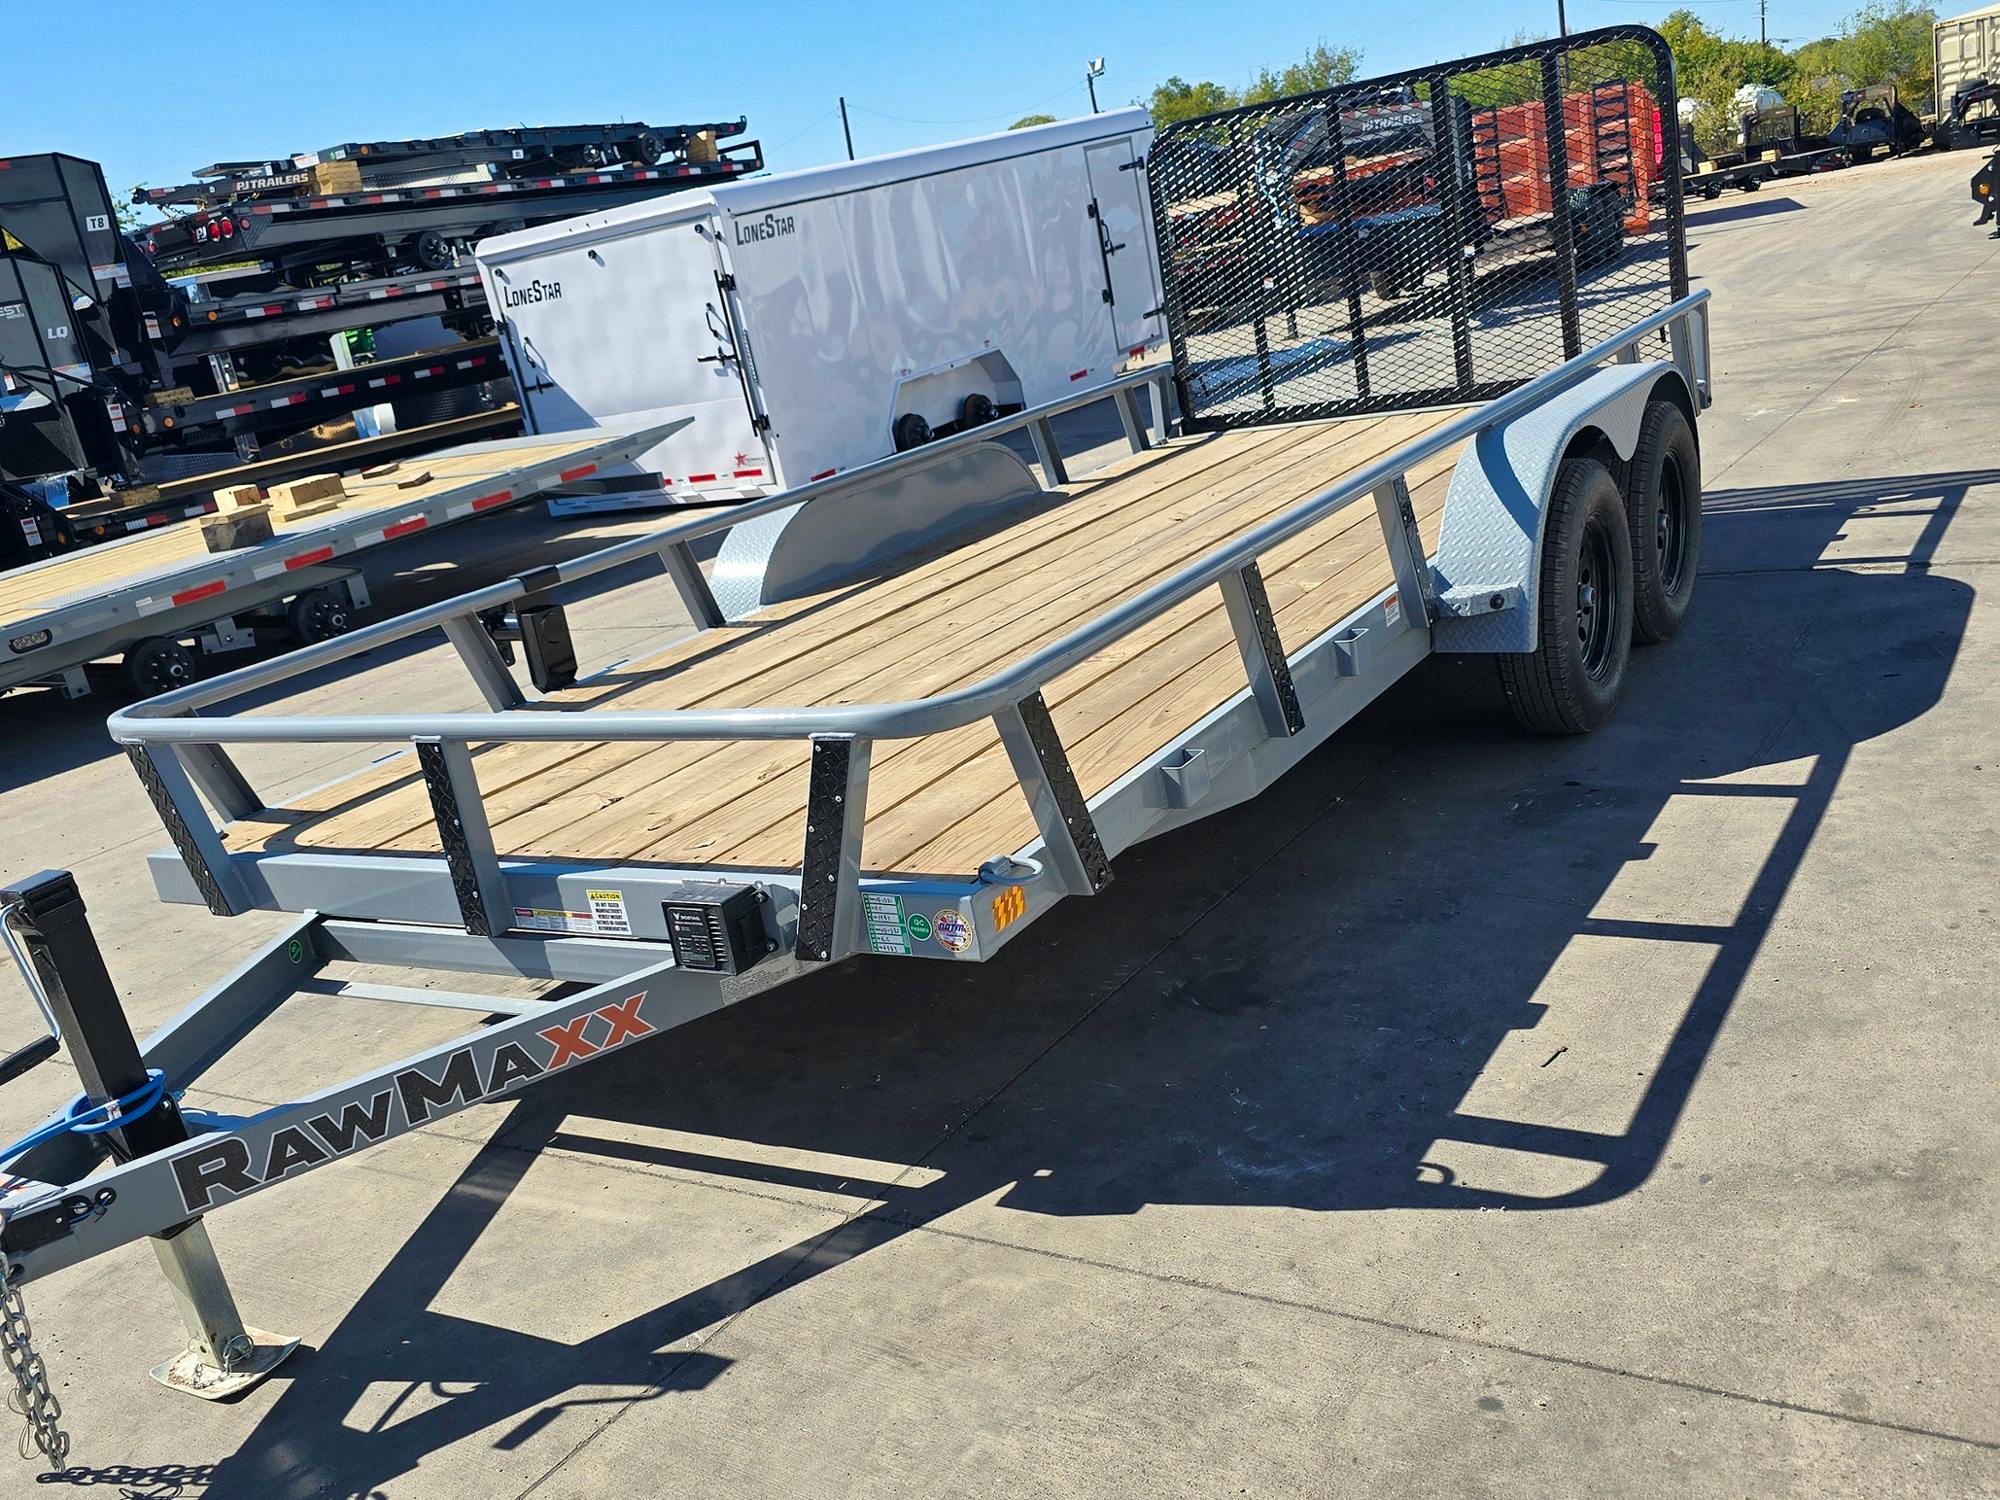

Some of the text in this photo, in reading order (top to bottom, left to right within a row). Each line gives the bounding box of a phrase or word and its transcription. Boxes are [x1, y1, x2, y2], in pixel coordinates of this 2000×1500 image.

[250, 173, 309, 189] TRAILERS
[90, 217, 105, 229] T8
[735, 213, 795, 246] LONESTAR
[504, 279, 562, 308] LONESTAR
[47, 326, 68, 340] LQ
[913, 918, 925, 926] QC
[168, 990, 658, 1215] RAWMAXX
